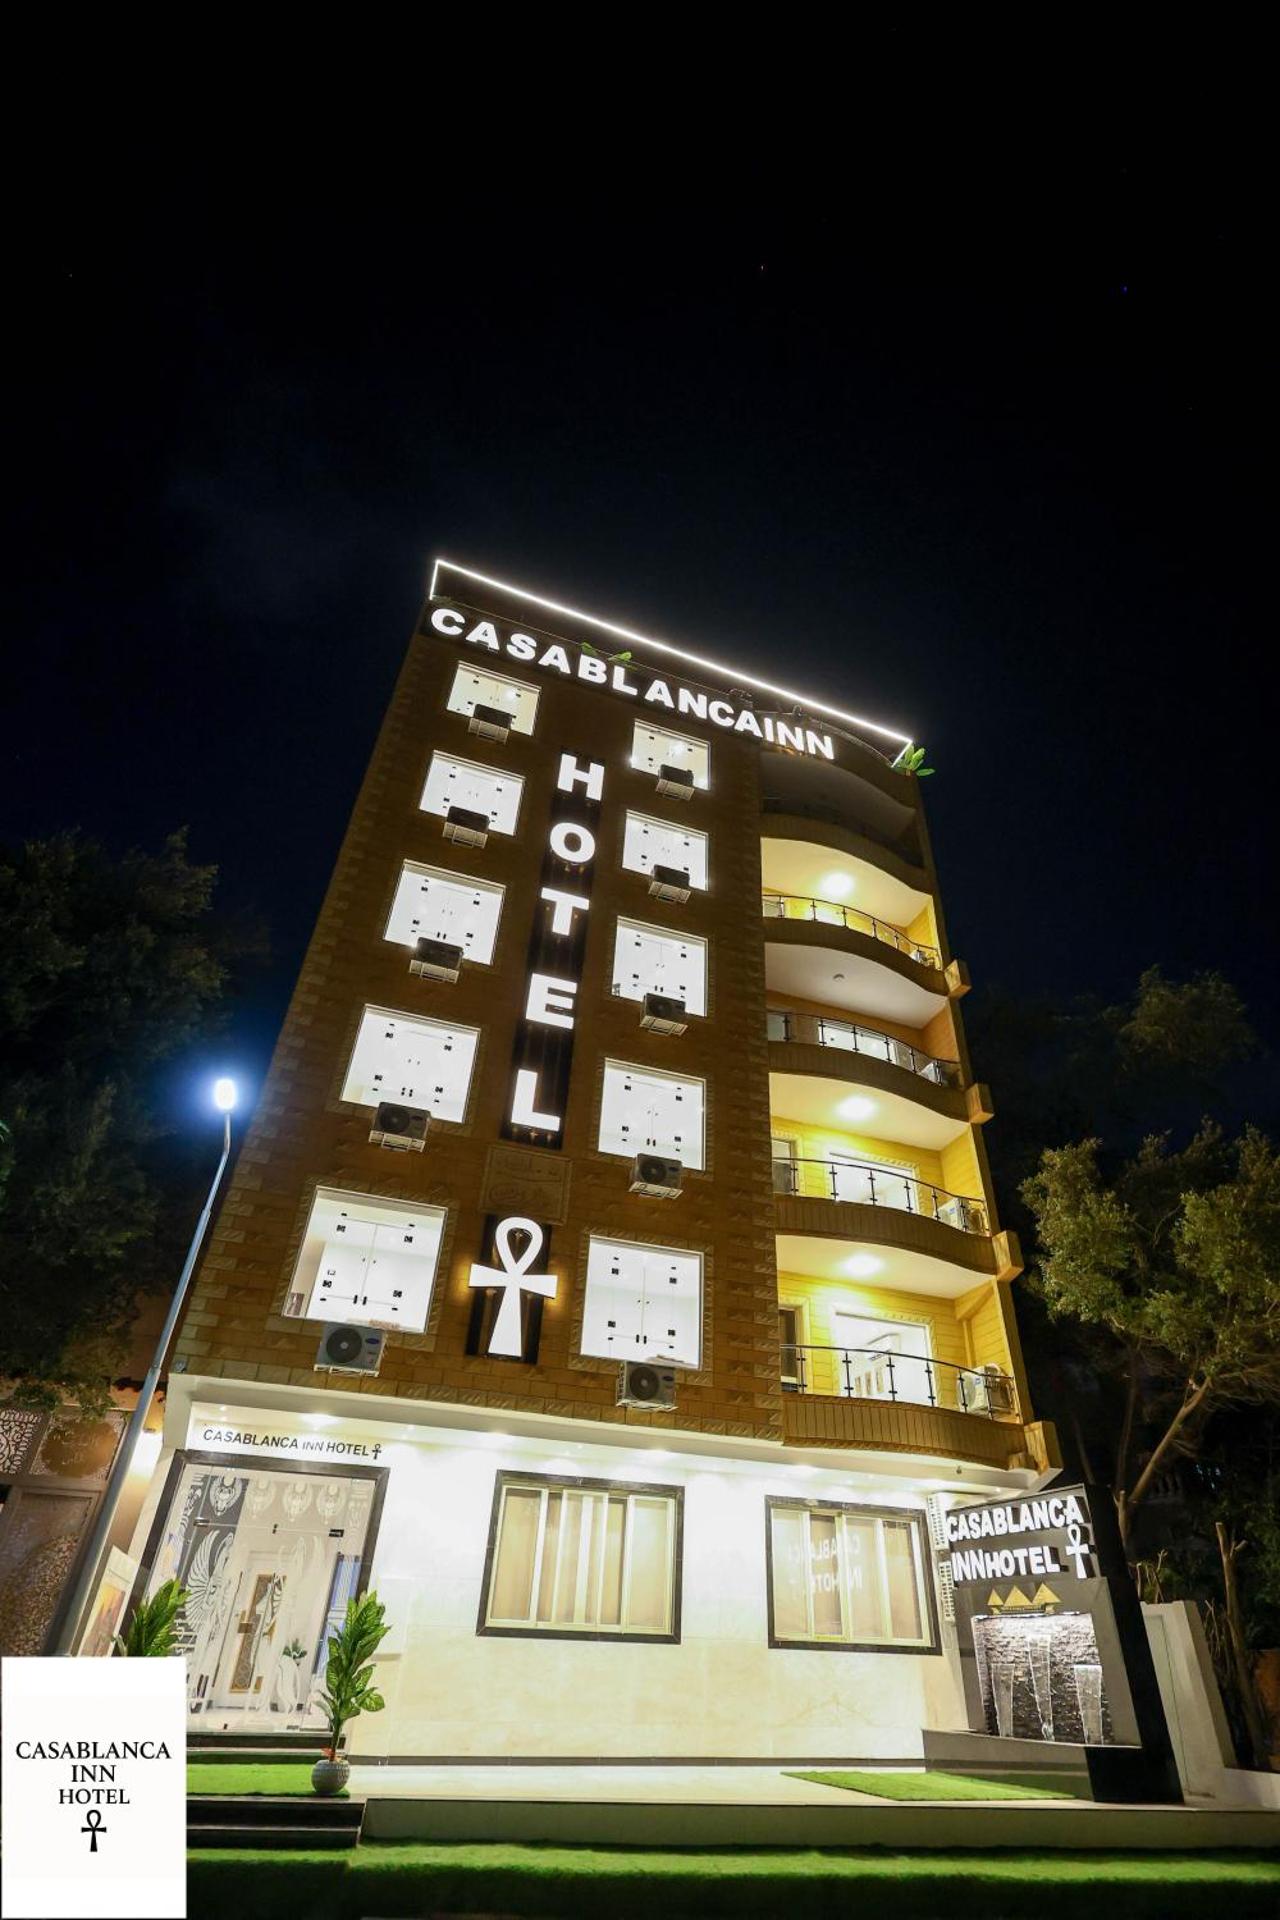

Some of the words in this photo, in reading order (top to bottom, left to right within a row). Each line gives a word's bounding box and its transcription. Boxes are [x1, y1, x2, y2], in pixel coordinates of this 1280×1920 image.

[511, 754, 605, 1132] HOTEL
[203, 1429, 298, 1449] CASABLANCA
[302, 1441, 323, 1452] INN
[326, 1442, 370, 1457] HOTEL
[946, 1495, 1084, 1542] CASABLANCA
